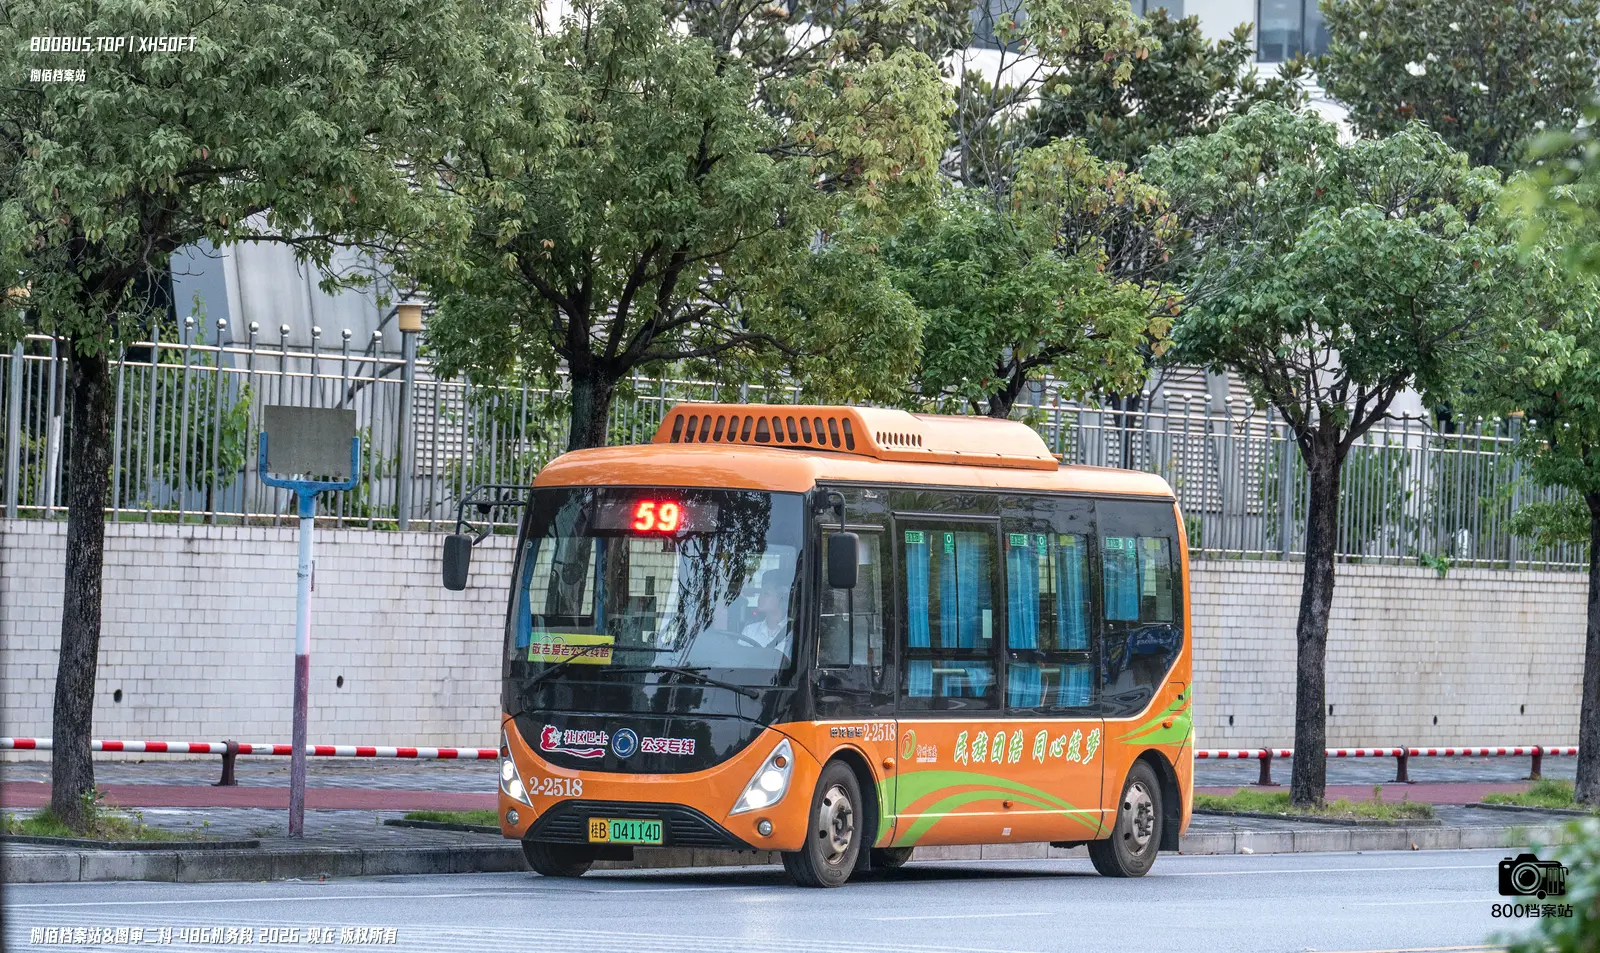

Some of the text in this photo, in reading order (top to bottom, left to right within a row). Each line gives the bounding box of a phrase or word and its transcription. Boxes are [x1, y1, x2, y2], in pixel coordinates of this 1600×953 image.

[634, 502, 679, 532] 59
[564, 730, 609, 745] 社区巴士
[863, 723, 897, 742] 2-2518
[641, 737, 696, 755] 公交专线
[954, 728, 1100, 766] 民族团结 同心筑梦
